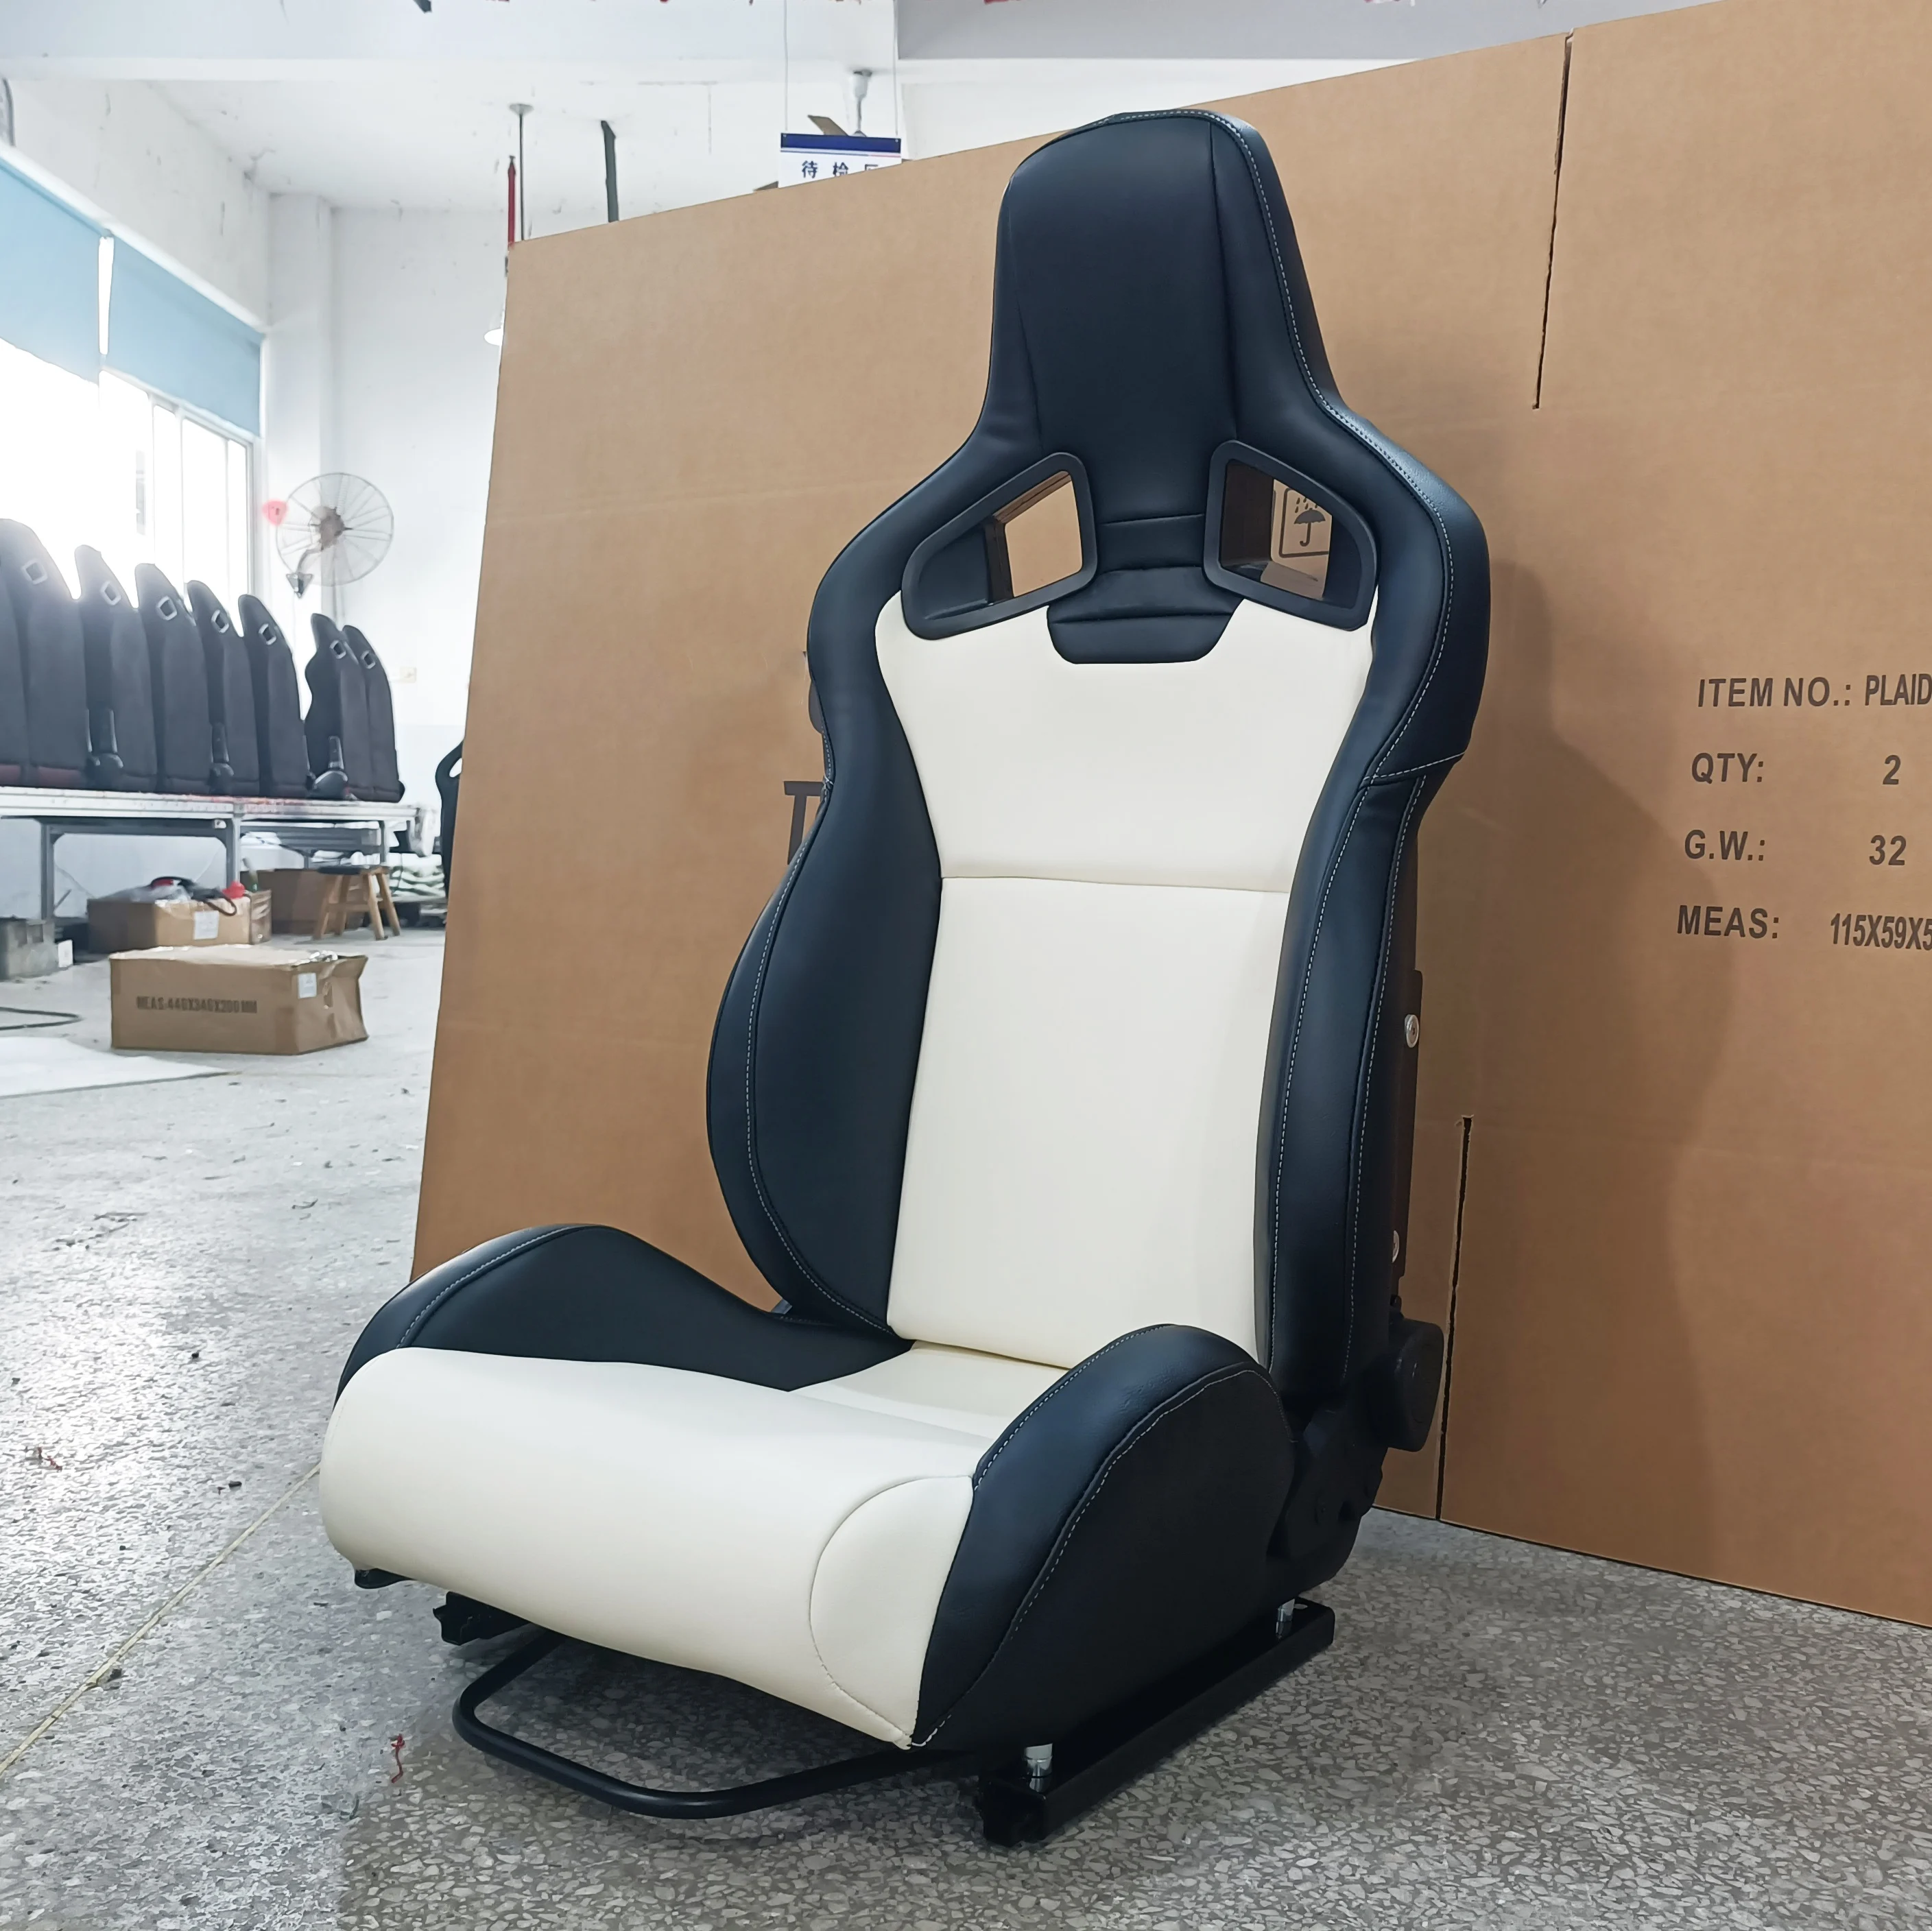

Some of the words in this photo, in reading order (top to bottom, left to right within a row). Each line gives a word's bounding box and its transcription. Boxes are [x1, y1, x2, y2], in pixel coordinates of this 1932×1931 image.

[1697, 677, 1774, 708] ITEM
[1783, 677, 1851, 707] NO.:
[1865, 673, 1932, 706] PLAID
[1691, 752, 1764, 784] QTY:
[1883, 754, 1901, 785] 2
[1684, 829, 1765, 861] G.W.:
[1869, 835, 1907, 866] 32
[1677, 904, 1779, 939] MEAS:
[1830, 913, 1932, 951] 115X59X5
